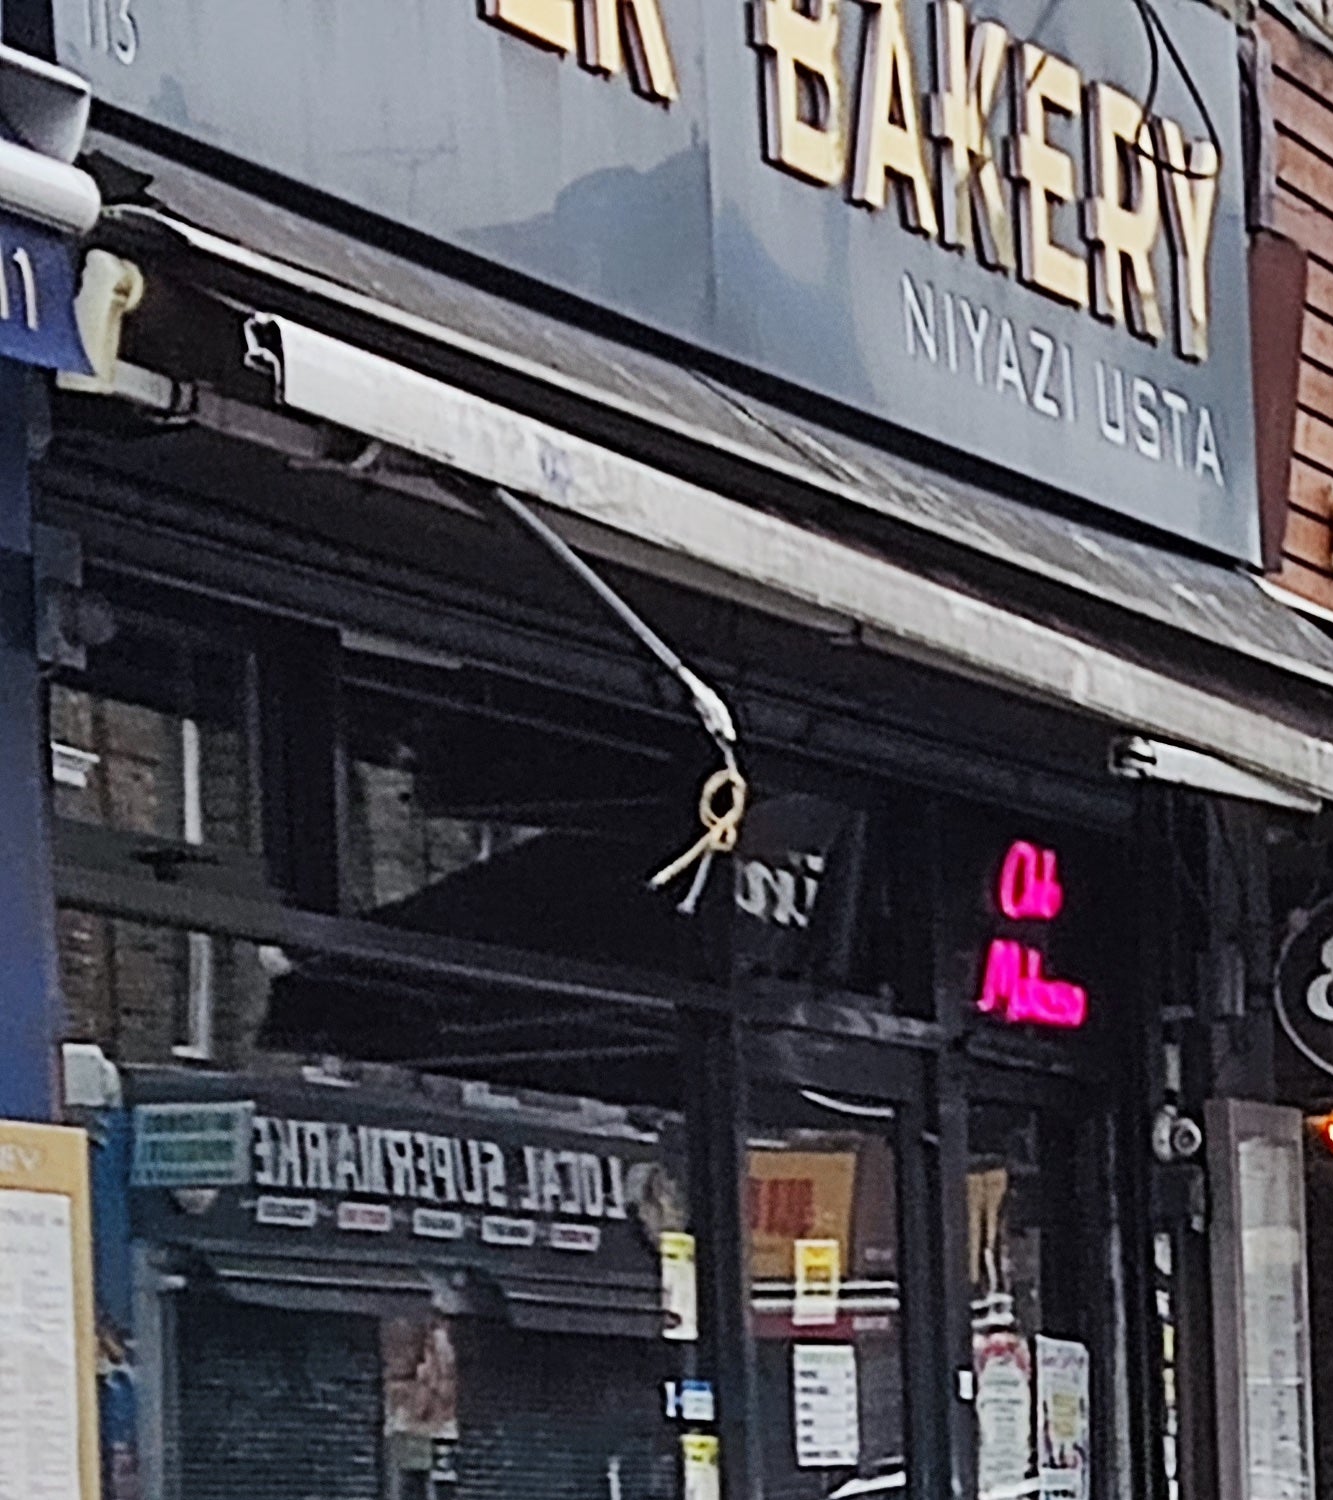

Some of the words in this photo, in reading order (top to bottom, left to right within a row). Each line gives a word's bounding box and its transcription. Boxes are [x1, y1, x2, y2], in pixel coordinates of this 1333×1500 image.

[747, 0, 1221, 364] BAKERY
[902, 273, 1077, 423] NIYAZI
[1096, 361, 1224, 488] USTA
